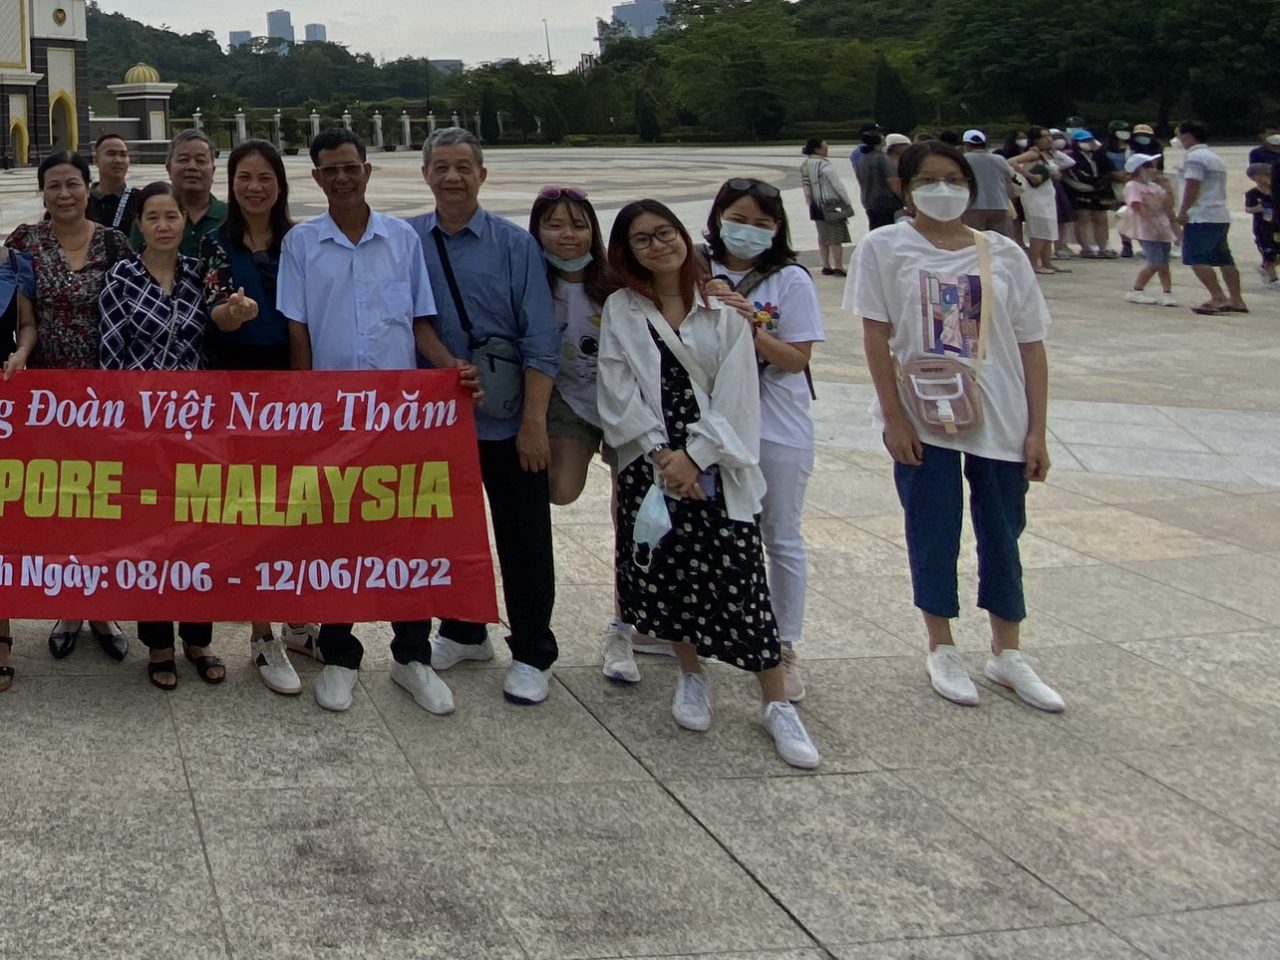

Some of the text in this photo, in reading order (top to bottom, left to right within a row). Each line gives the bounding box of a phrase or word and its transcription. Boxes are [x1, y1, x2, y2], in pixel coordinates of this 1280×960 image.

[25, 386, 126, 430] Đoàn
[139, 390, 216, 440] Việt
[226, 391, 325, 431] Nam
[336, 390, 458, 431] Thăm
[140, 489, 158, 505] -
[174, 461, 455, 527] MALAYSIA
[20, 554, 109, 597] Ngày:
[115, 559, 213, 595] 08/06
[254, 556, 452, 596] 12/06/2022
